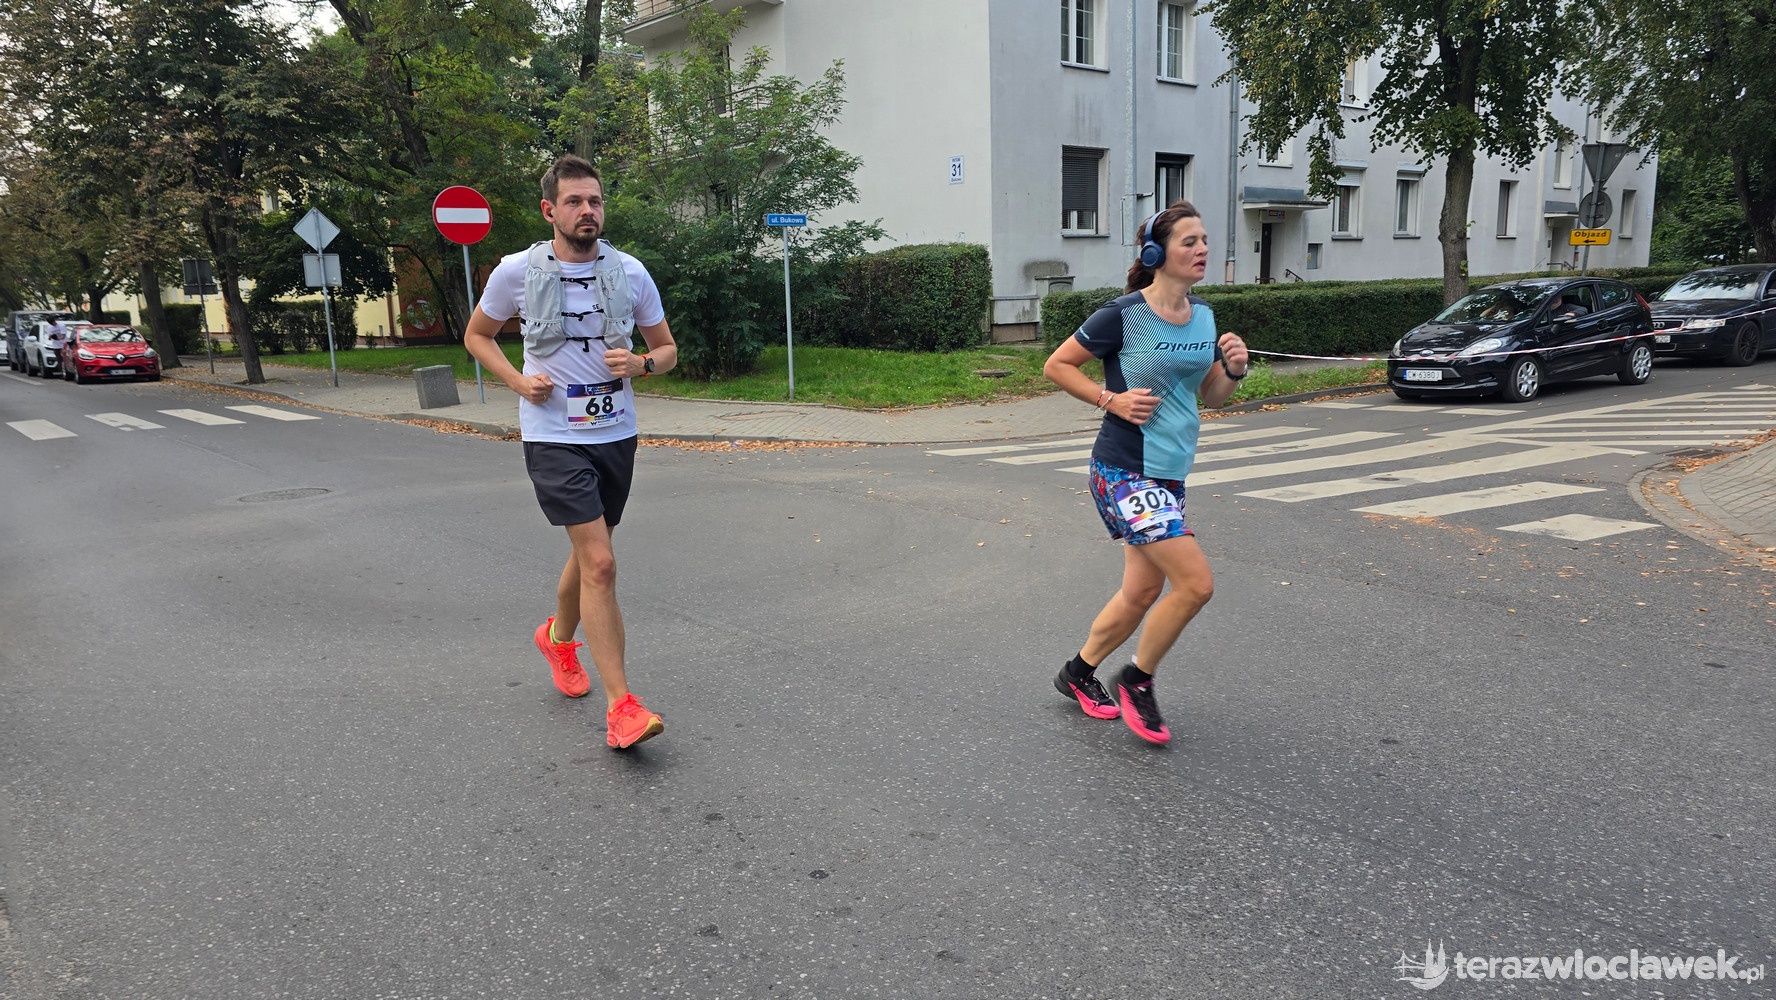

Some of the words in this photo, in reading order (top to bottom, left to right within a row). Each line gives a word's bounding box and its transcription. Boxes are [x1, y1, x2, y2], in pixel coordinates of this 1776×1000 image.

[951, 163, 961, 177] 31
[780, 216, 804, 224] Bukowa
[585, 395, 614, 416] 68
[1128, 489, 1173, 515] 302
